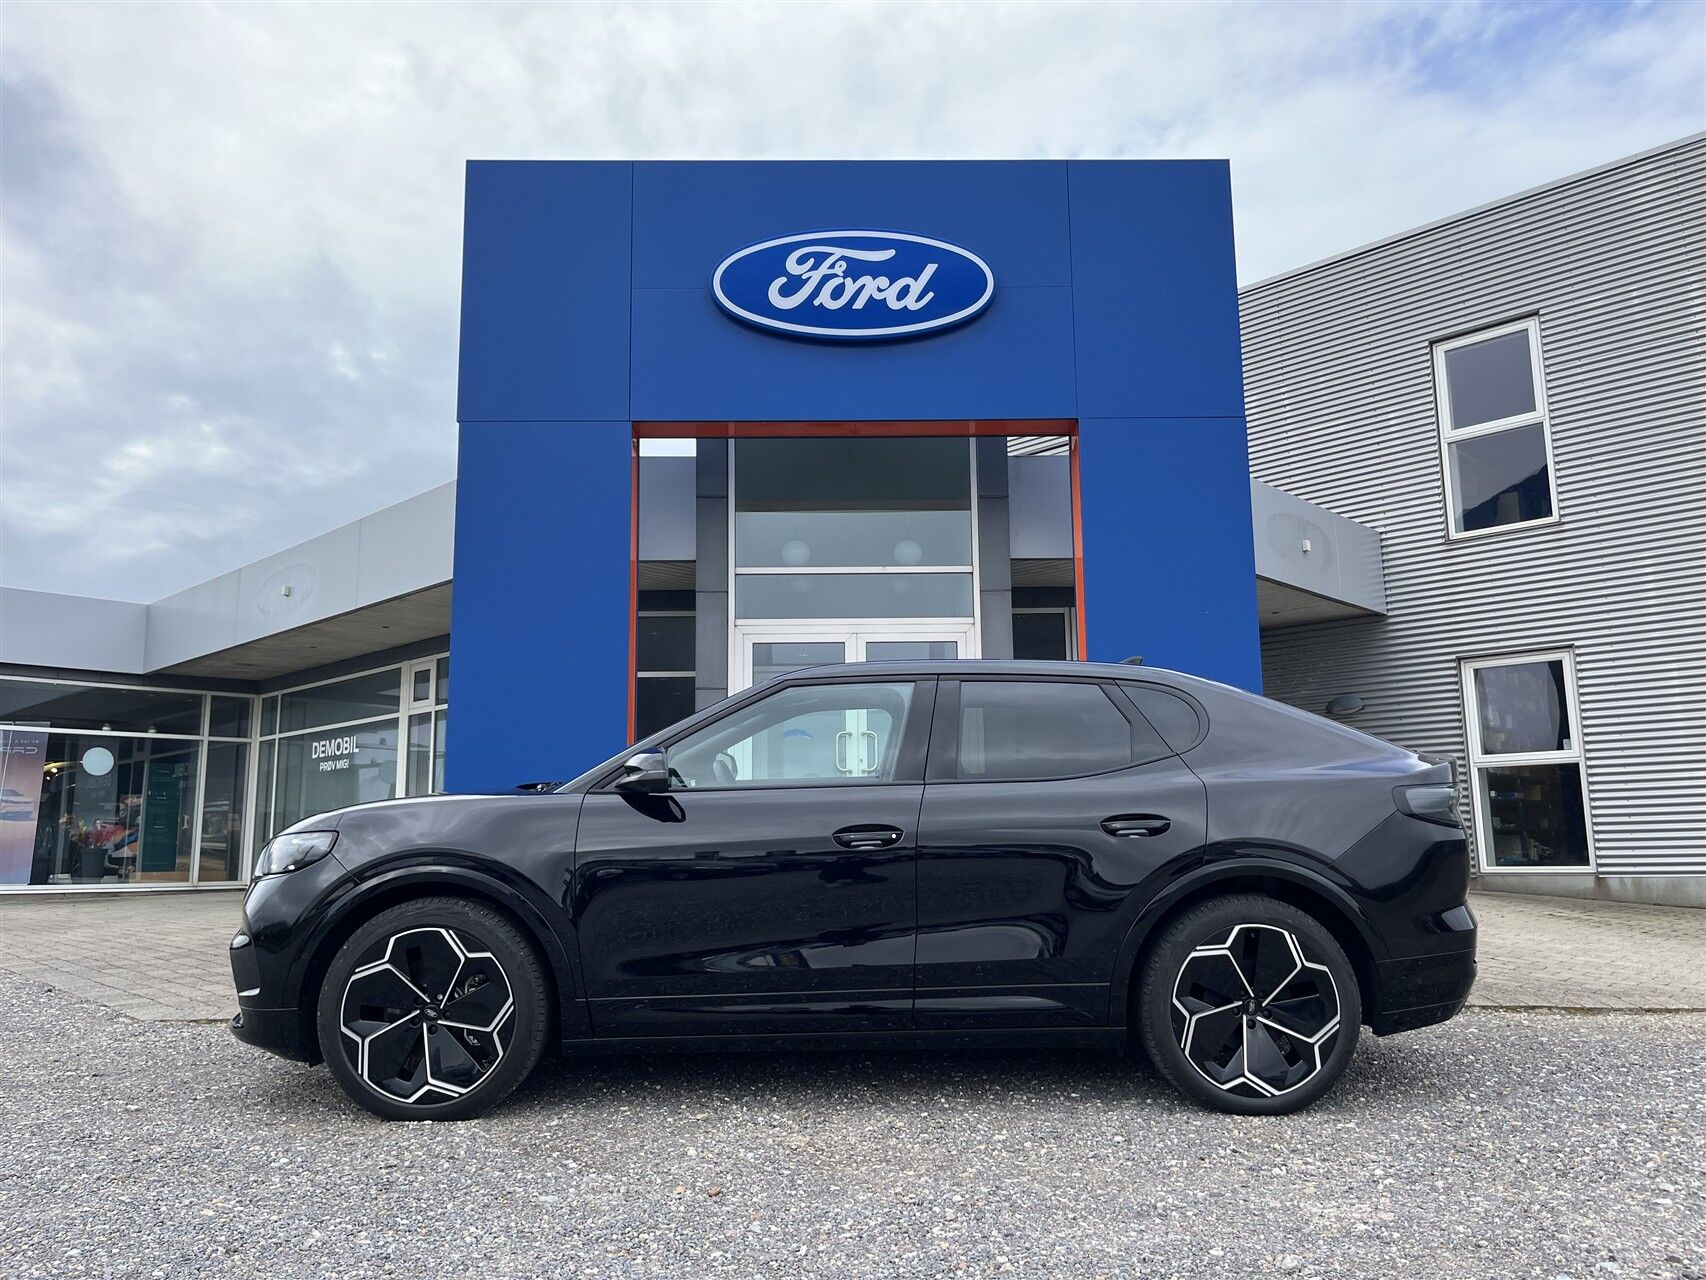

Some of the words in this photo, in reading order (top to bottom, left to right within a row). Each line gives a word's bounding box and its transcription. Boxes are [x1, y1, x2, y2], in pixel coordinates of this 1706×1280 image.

[768, 245, 939, 311] Ford
[312, 736, 359, 759] DEMOBIL
[320, 760, 336, 771] PRØV
